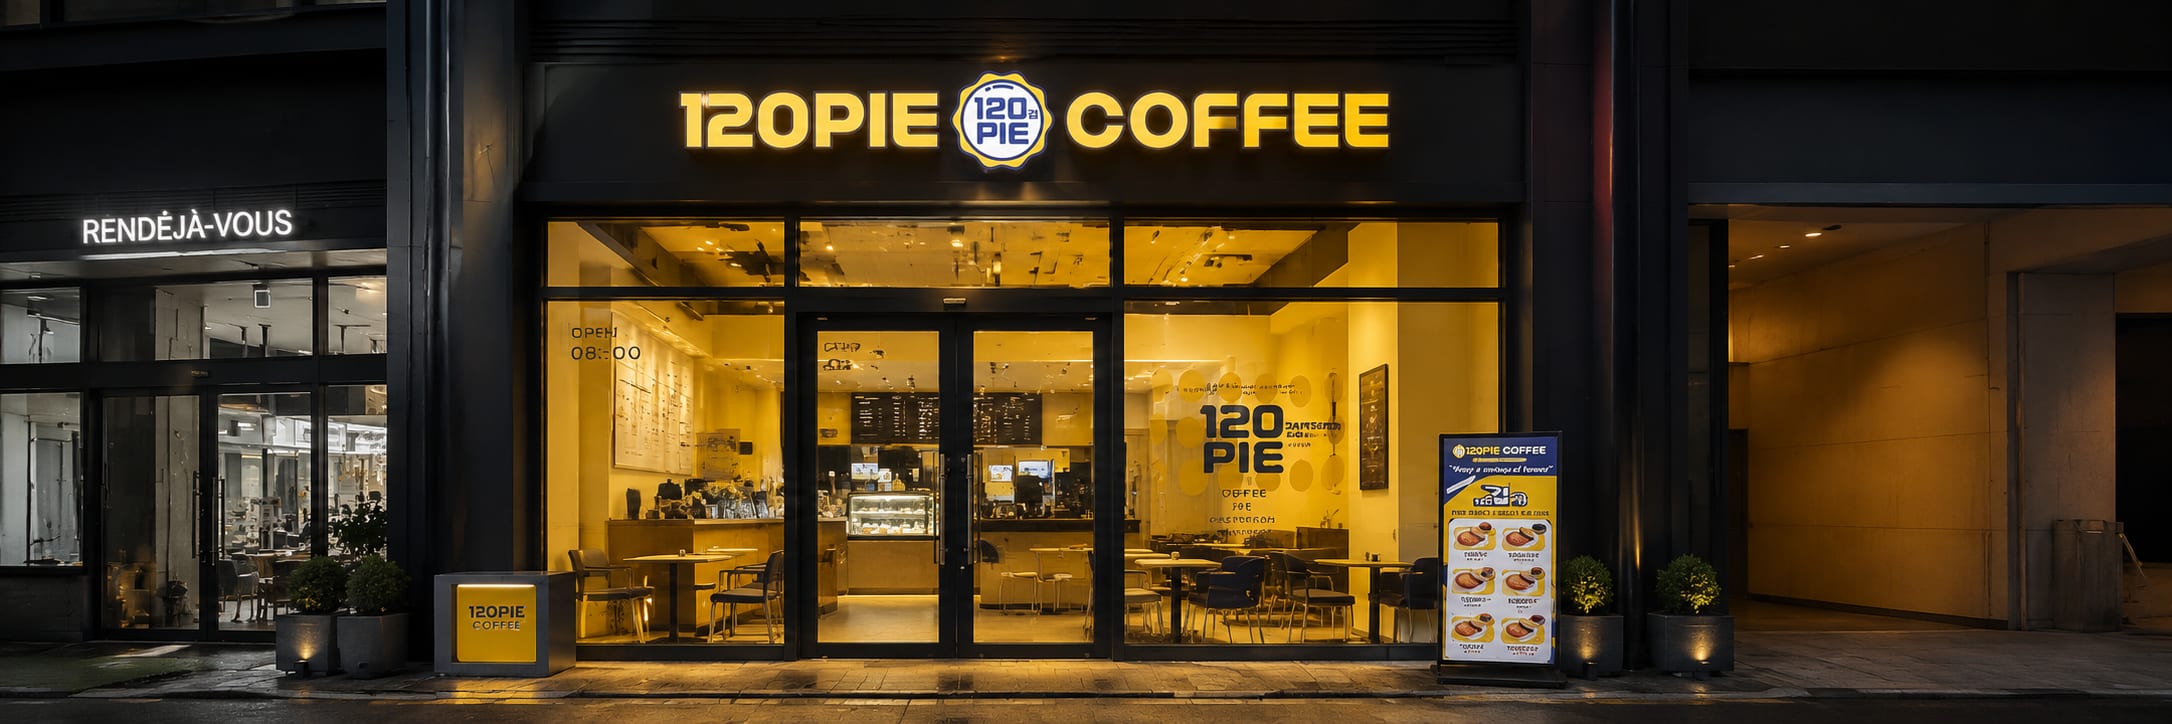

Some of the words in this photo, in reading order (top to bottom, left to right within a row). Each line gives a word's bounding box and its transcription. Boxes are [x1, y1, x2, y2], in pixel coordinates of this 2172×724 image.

[974, 97, 1027, 120] 120
[680, 92, 939, 149] 120PIE
[1066, 92, 1389, 149] COFFEE
[977, 122, 1029, 145] PIE
[1200, 405, 1284, 438] 120
[1203, 441, 1284, 474] PIE
[1465, 446, 1500, 455] 120PIE
[1502, 446, 1546, 455] COFFEE
[468, 605, 525, 618] 120PIE
[472, 621, 520, 630] COFFEE
